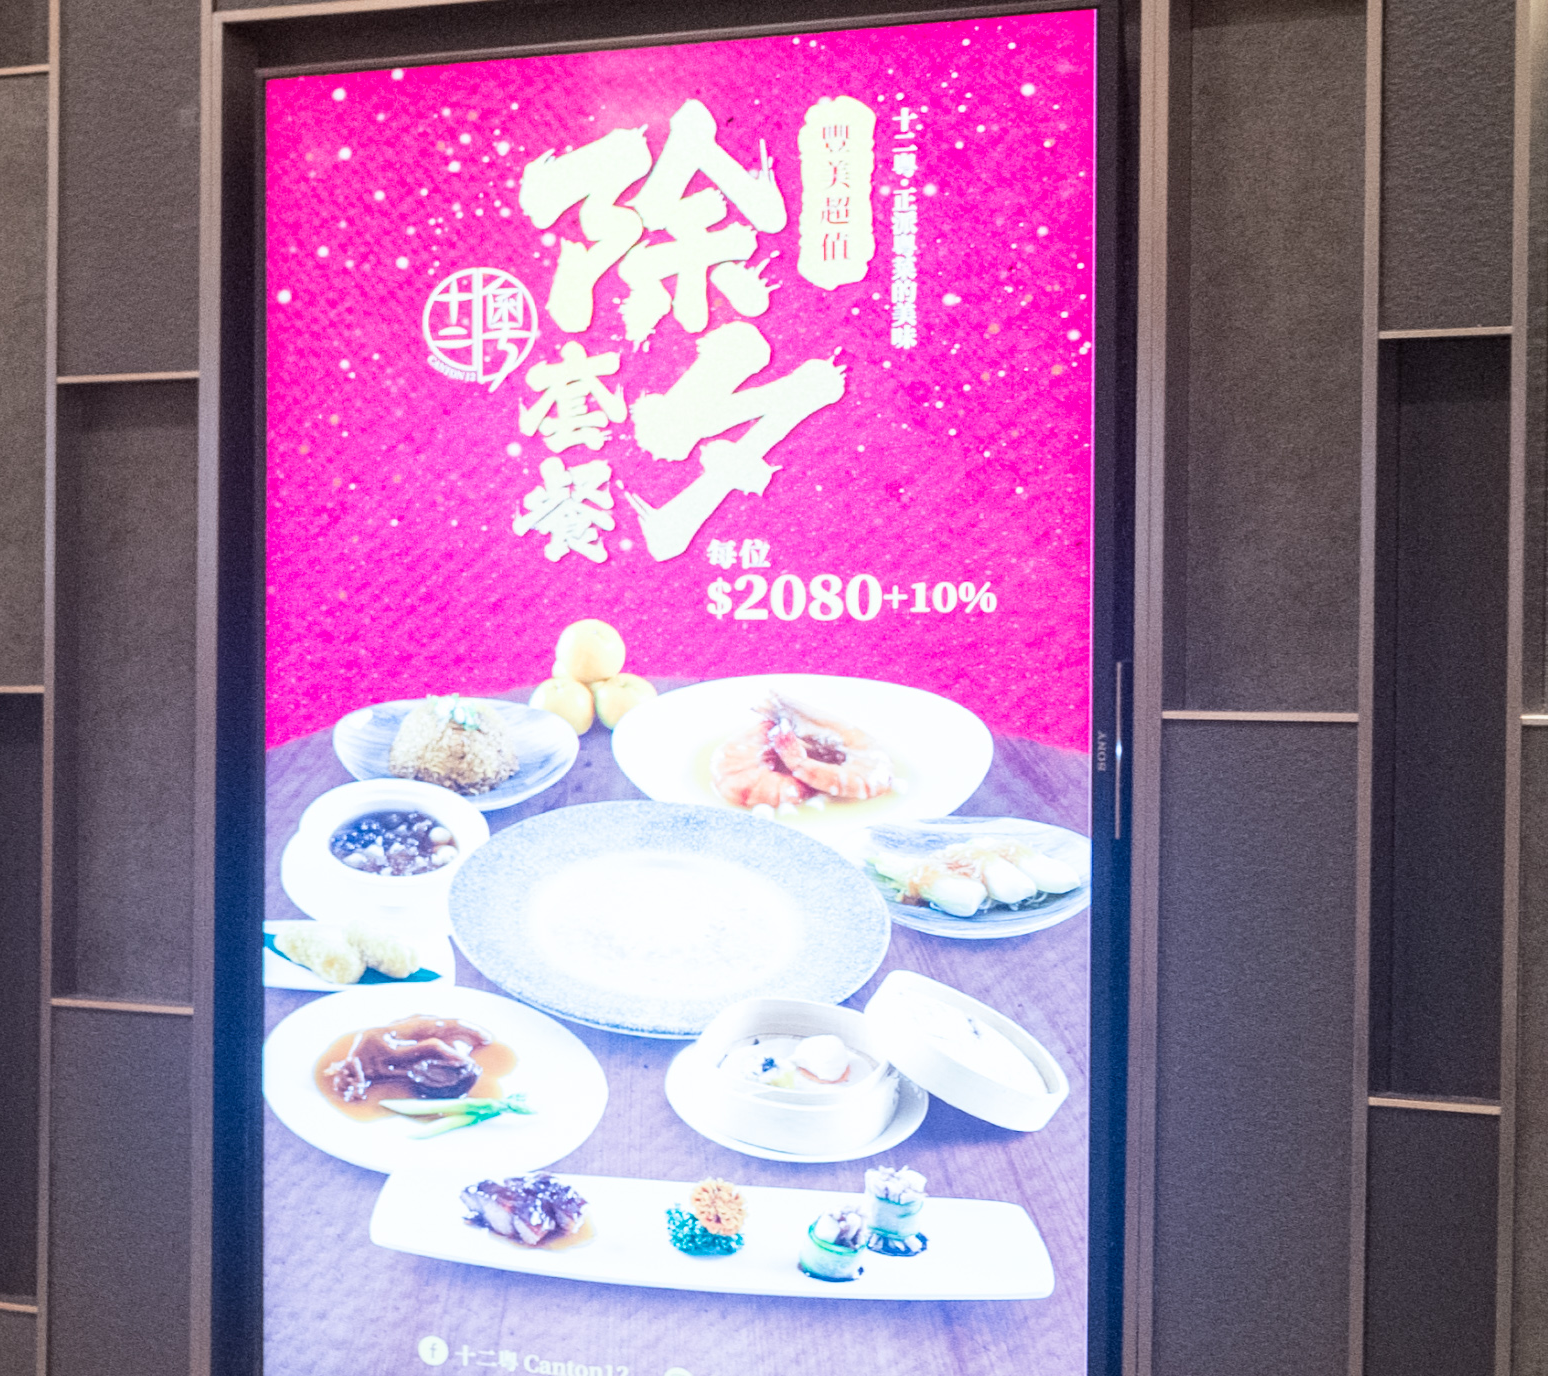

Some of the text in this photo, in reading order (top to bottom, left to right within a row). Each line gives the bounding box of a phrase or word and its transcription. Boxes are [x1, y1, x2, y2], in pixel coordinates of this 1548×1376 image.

[512, 340, 627, 564] 套餐
[706, 538, 771, 570] 每位
[1096, 730, 1107, 772] SONY
